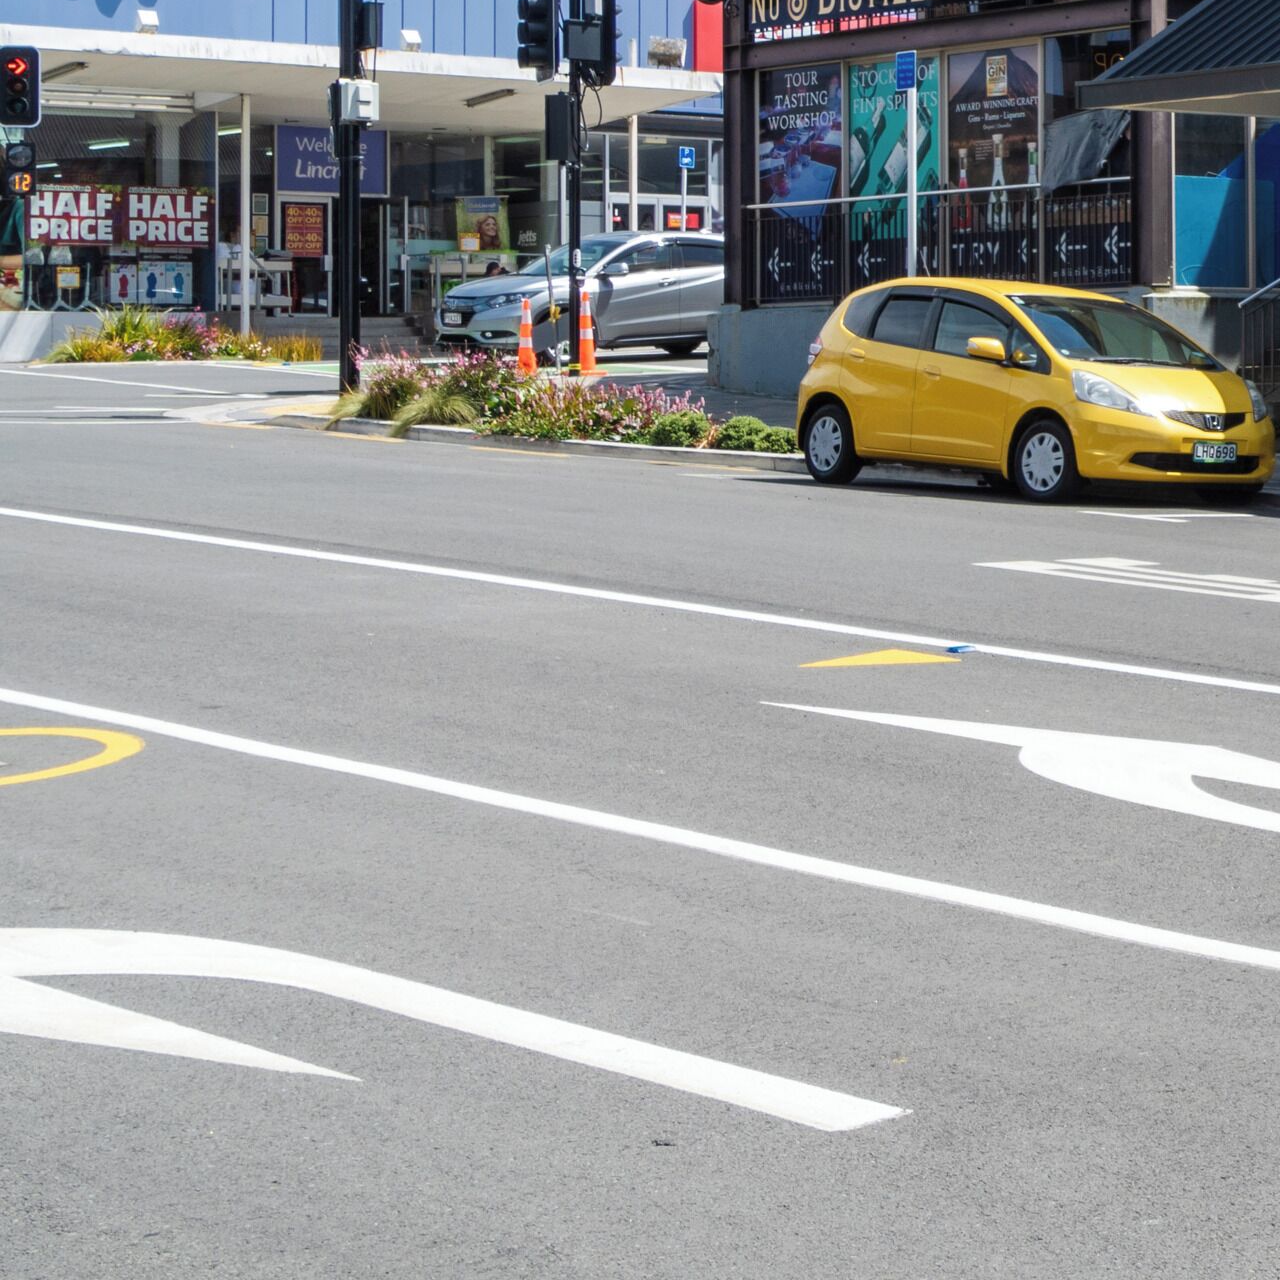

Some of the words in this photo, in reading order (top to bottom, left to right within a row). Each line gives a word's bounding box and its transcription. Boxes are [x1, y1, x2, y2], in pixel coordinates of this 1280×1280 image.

[784, 70, 819, 89] TOUR
[852, 69, 898, 88] STOCK
[917, 64, 936, 81] OF
[988, 63, 1006, 78] GIN
[774, 90, 828, 110] TASTING
[887, 90, 938, 111] SPIITS
[955, 100, 981, 113] AWARD
[982, 97, 1016, 110] WINNING
[1016, 95, 1040, 106] CRAFT
[767, 111, 837, 132] WORKSHOP
[967, 113, 981, 124] Gins
[295, 136, 368, 155] Welce
[295, 158, 367, 181] Lincrt
[14, 173, 31, 192] 12
[30, 192, 114, 218] HALF
[128, 194, 209, 219] HALF
[30, 217, 114, 241] PRICE
[128, 220, 209, 242] PRICE
[1194, 444, 1236, 460] LHQ698
